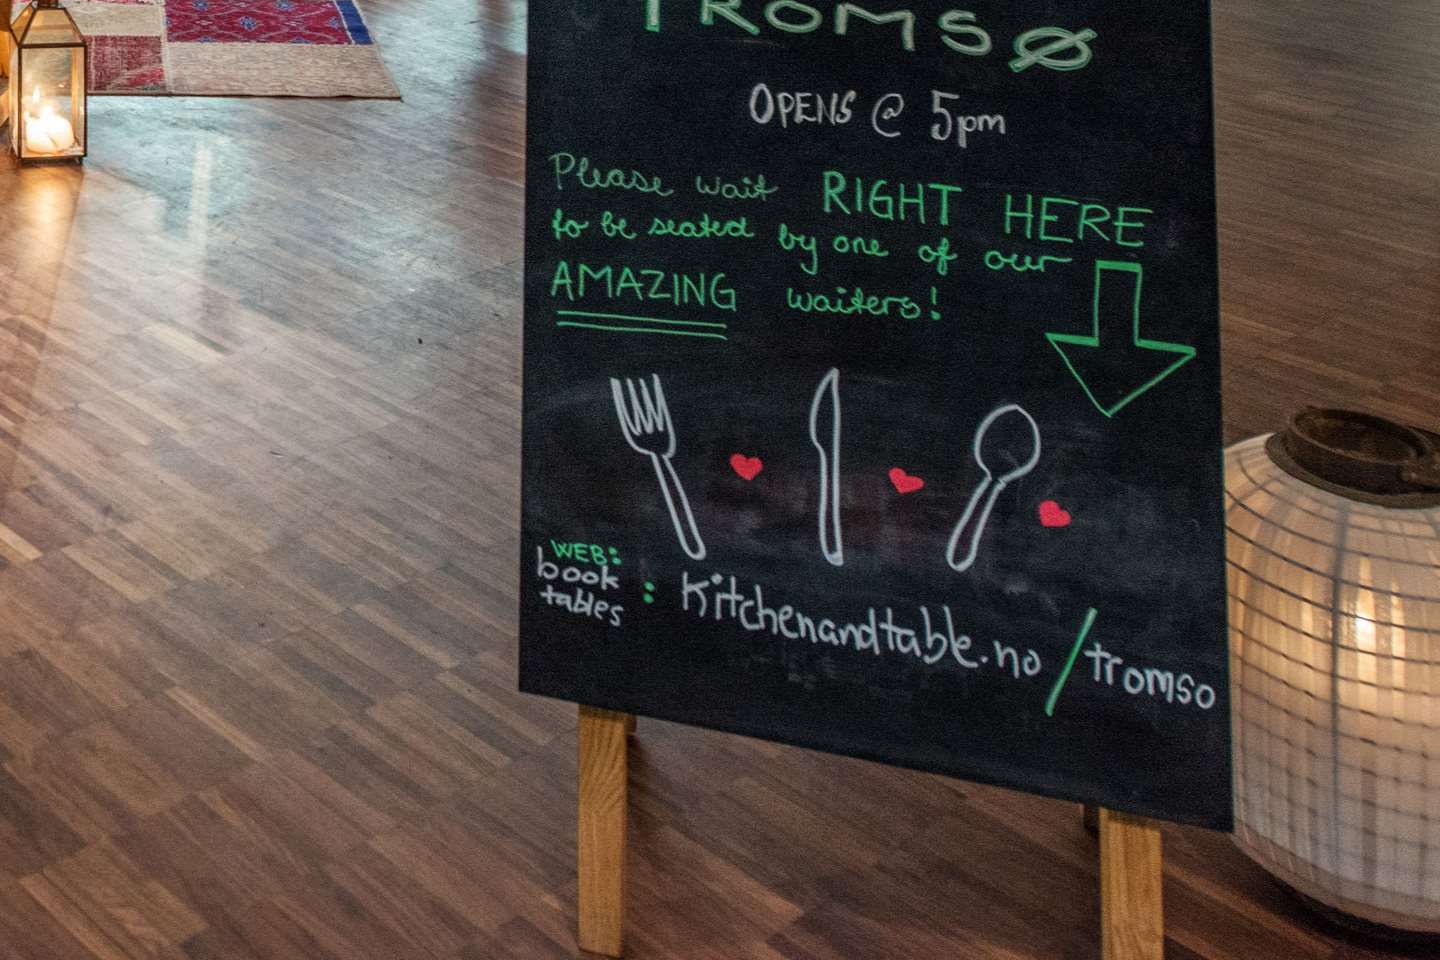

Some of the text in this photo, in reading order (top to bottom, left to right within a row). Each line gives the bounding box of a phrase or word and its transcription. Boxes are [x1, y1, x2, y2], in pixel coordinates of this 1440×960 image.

[748, 81, 1007, 149] OPENS @ 5pm
[548, 152, 1153, 248] Please wait RIGHT HERE
[551, 207, 1074, 276] to be seated by one of our
[550, 260, 942, 321] AMAZING waiters!
[536, 544, 621, 591] book
[550, 539, 623, 566] WEB:
[539, 583, 625, 628] tables
